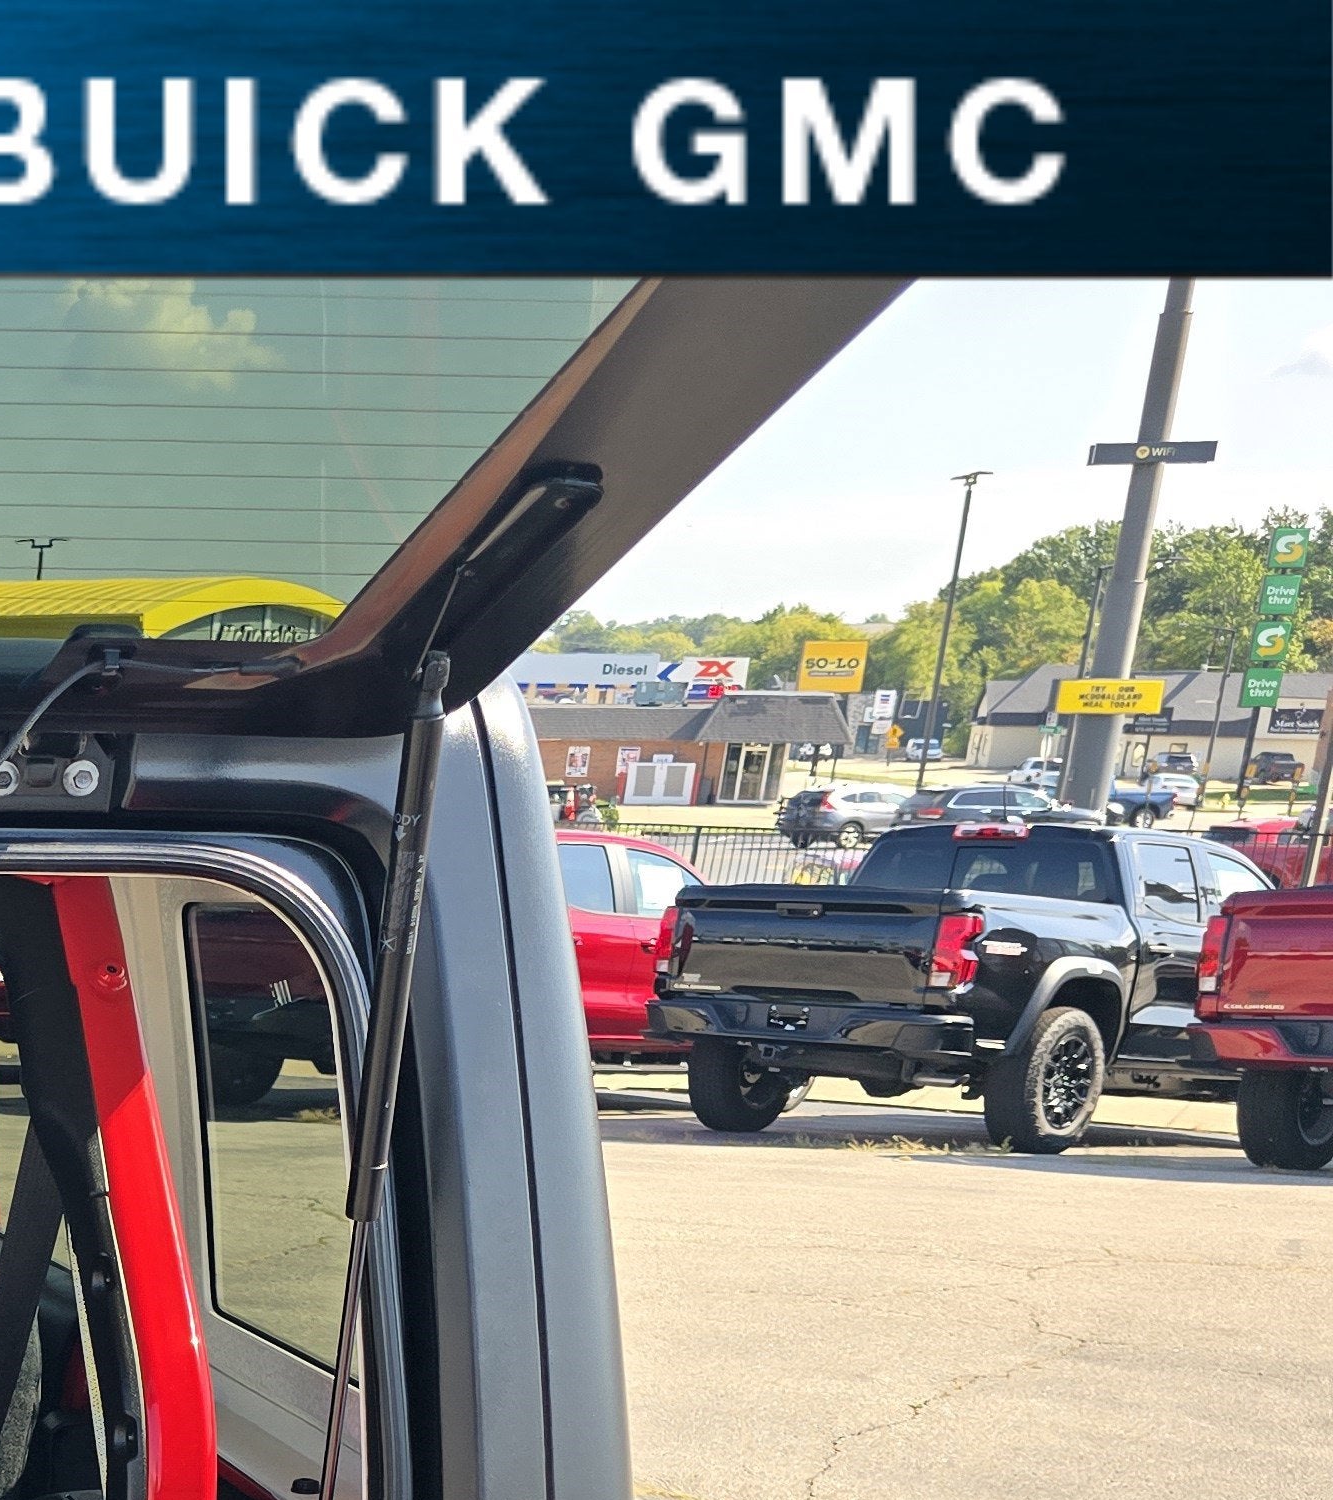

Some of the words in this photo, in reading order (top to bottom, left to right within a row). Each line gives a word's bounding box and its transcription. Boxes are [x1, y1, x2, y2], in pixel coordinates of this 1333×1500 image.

[1266, 585, 1297, 596] Drive
[1267, 595, 1293, 605] thru
[805, 657, 860, 669] SO-LO
[602, 663, 648, 675] Diesel
[1247, 678, 1278, 689] Drive
[1248, 688, 1275, 698] thru
